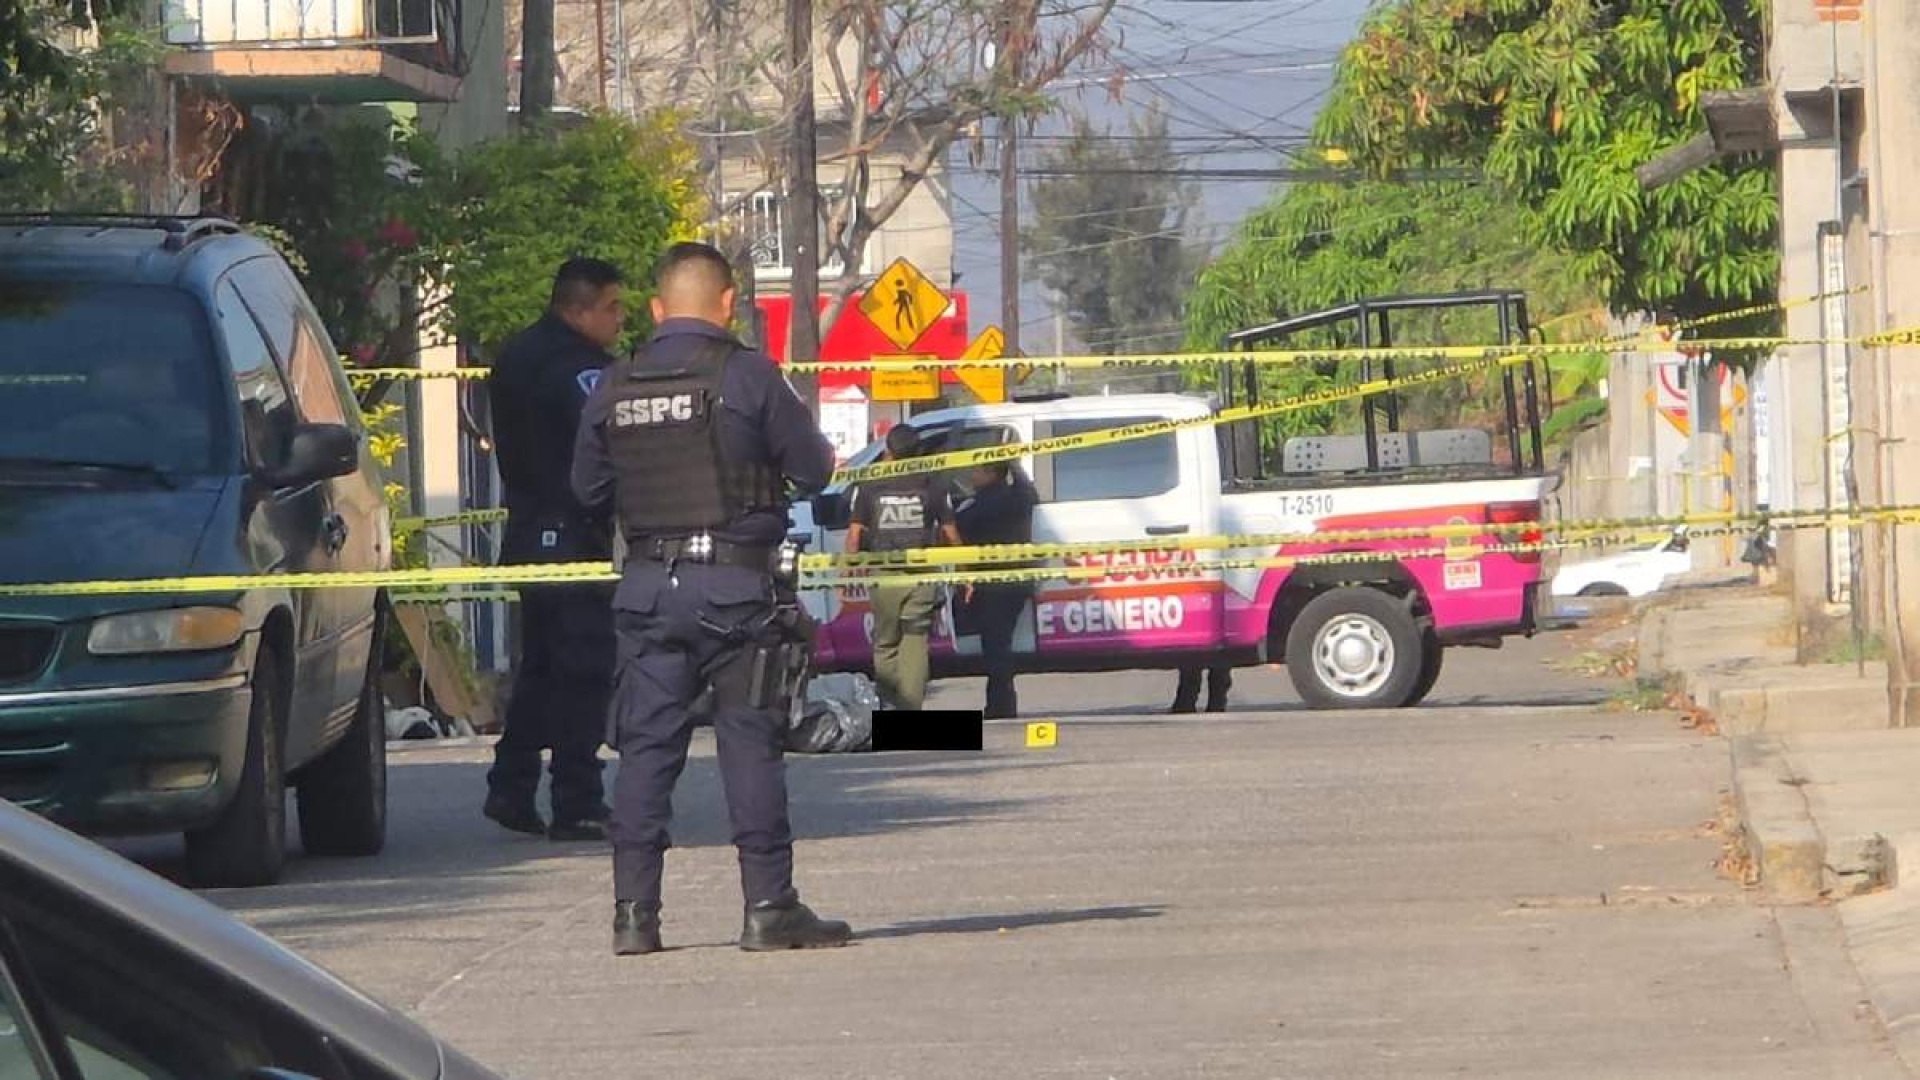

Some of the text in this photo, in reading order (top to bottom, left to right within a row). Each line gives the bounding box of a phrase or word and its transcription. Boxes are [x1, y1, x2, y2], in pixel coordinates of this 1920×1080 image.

[615, 394, 692, 427] SSPC
[834, 455, 948, 483] PRECAUCION
[879, 504, 924, 526] AIC
[1279, 495, 1334, 515] T-2510
[1037, 603, 1055, 634] E
[1036, 725, 1048, 739] C
